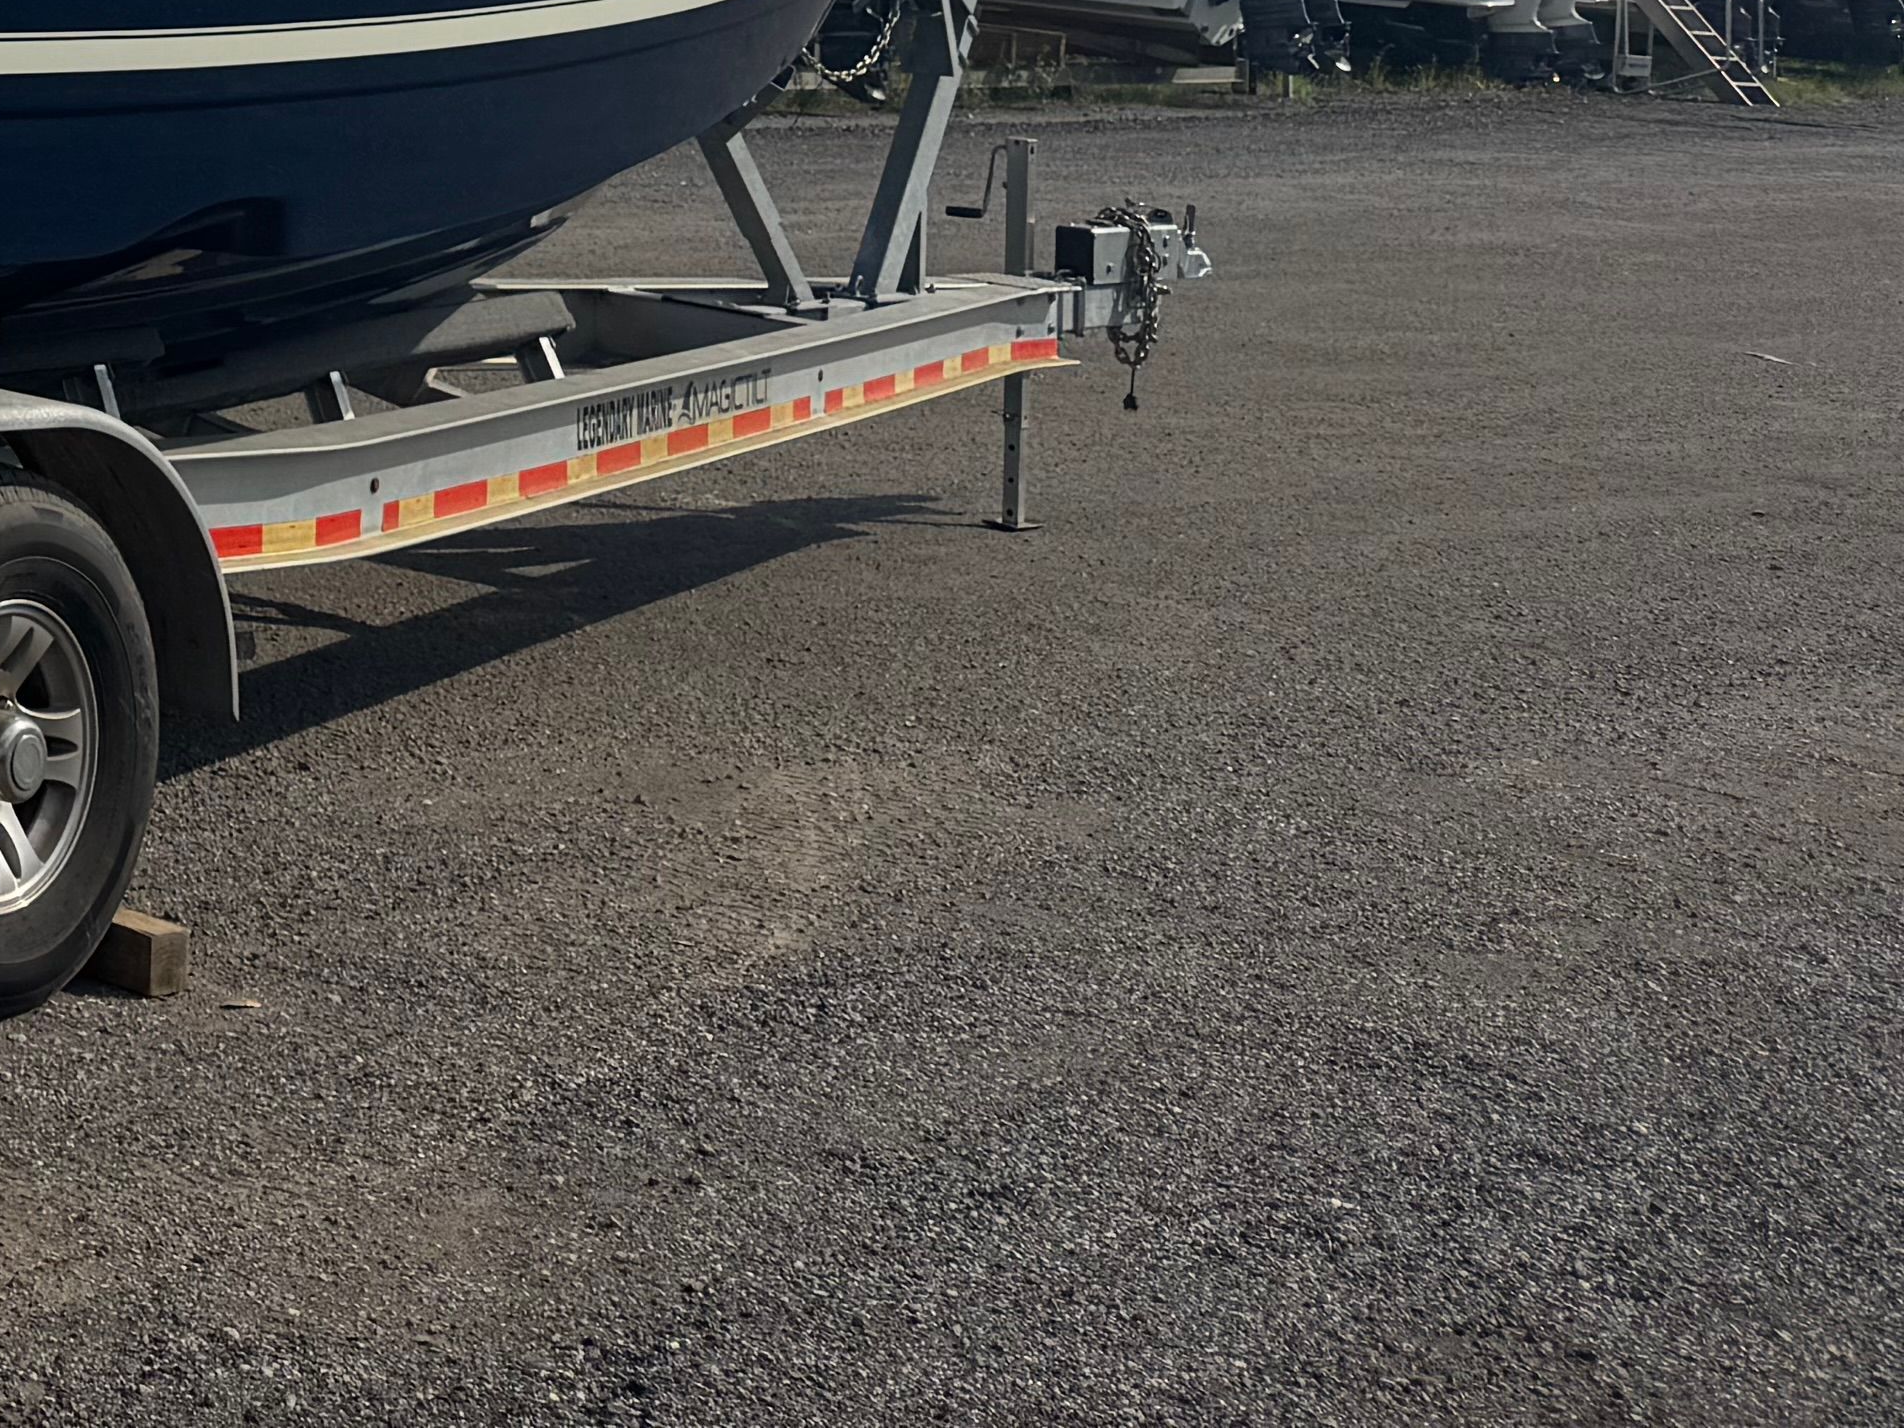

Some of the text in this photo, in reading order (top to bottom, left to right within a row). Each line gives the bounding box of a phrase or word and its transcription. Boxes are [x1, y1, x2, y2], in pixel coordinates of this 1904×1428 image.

[576, 367, 772, 451] LEGENDARY MARINE MAGICTILT
